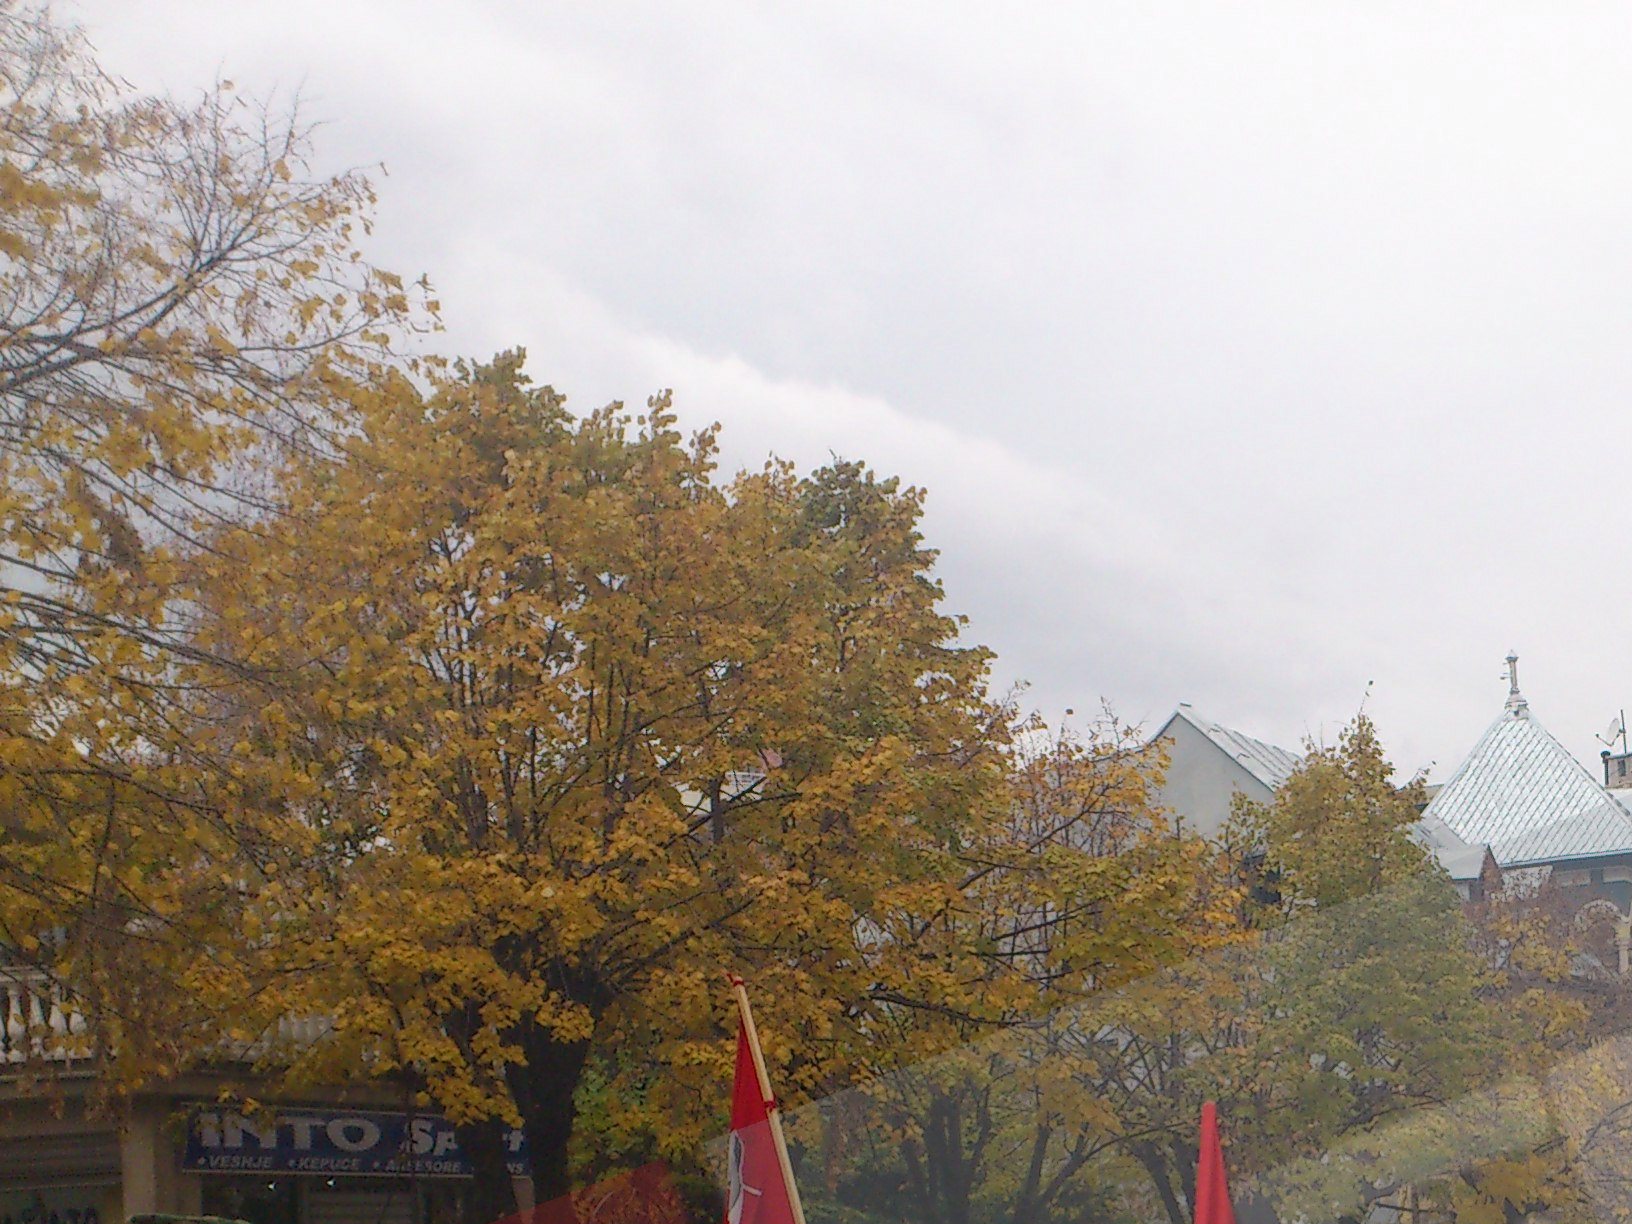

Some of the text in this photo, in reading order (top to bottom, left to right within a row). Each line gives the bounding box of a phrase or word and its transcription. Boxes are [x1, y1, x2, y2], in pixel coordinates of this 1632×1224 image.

[198, 1112, 525, 1156] INTO Spt
[208, 1155, 273, 1169] VESHJE
